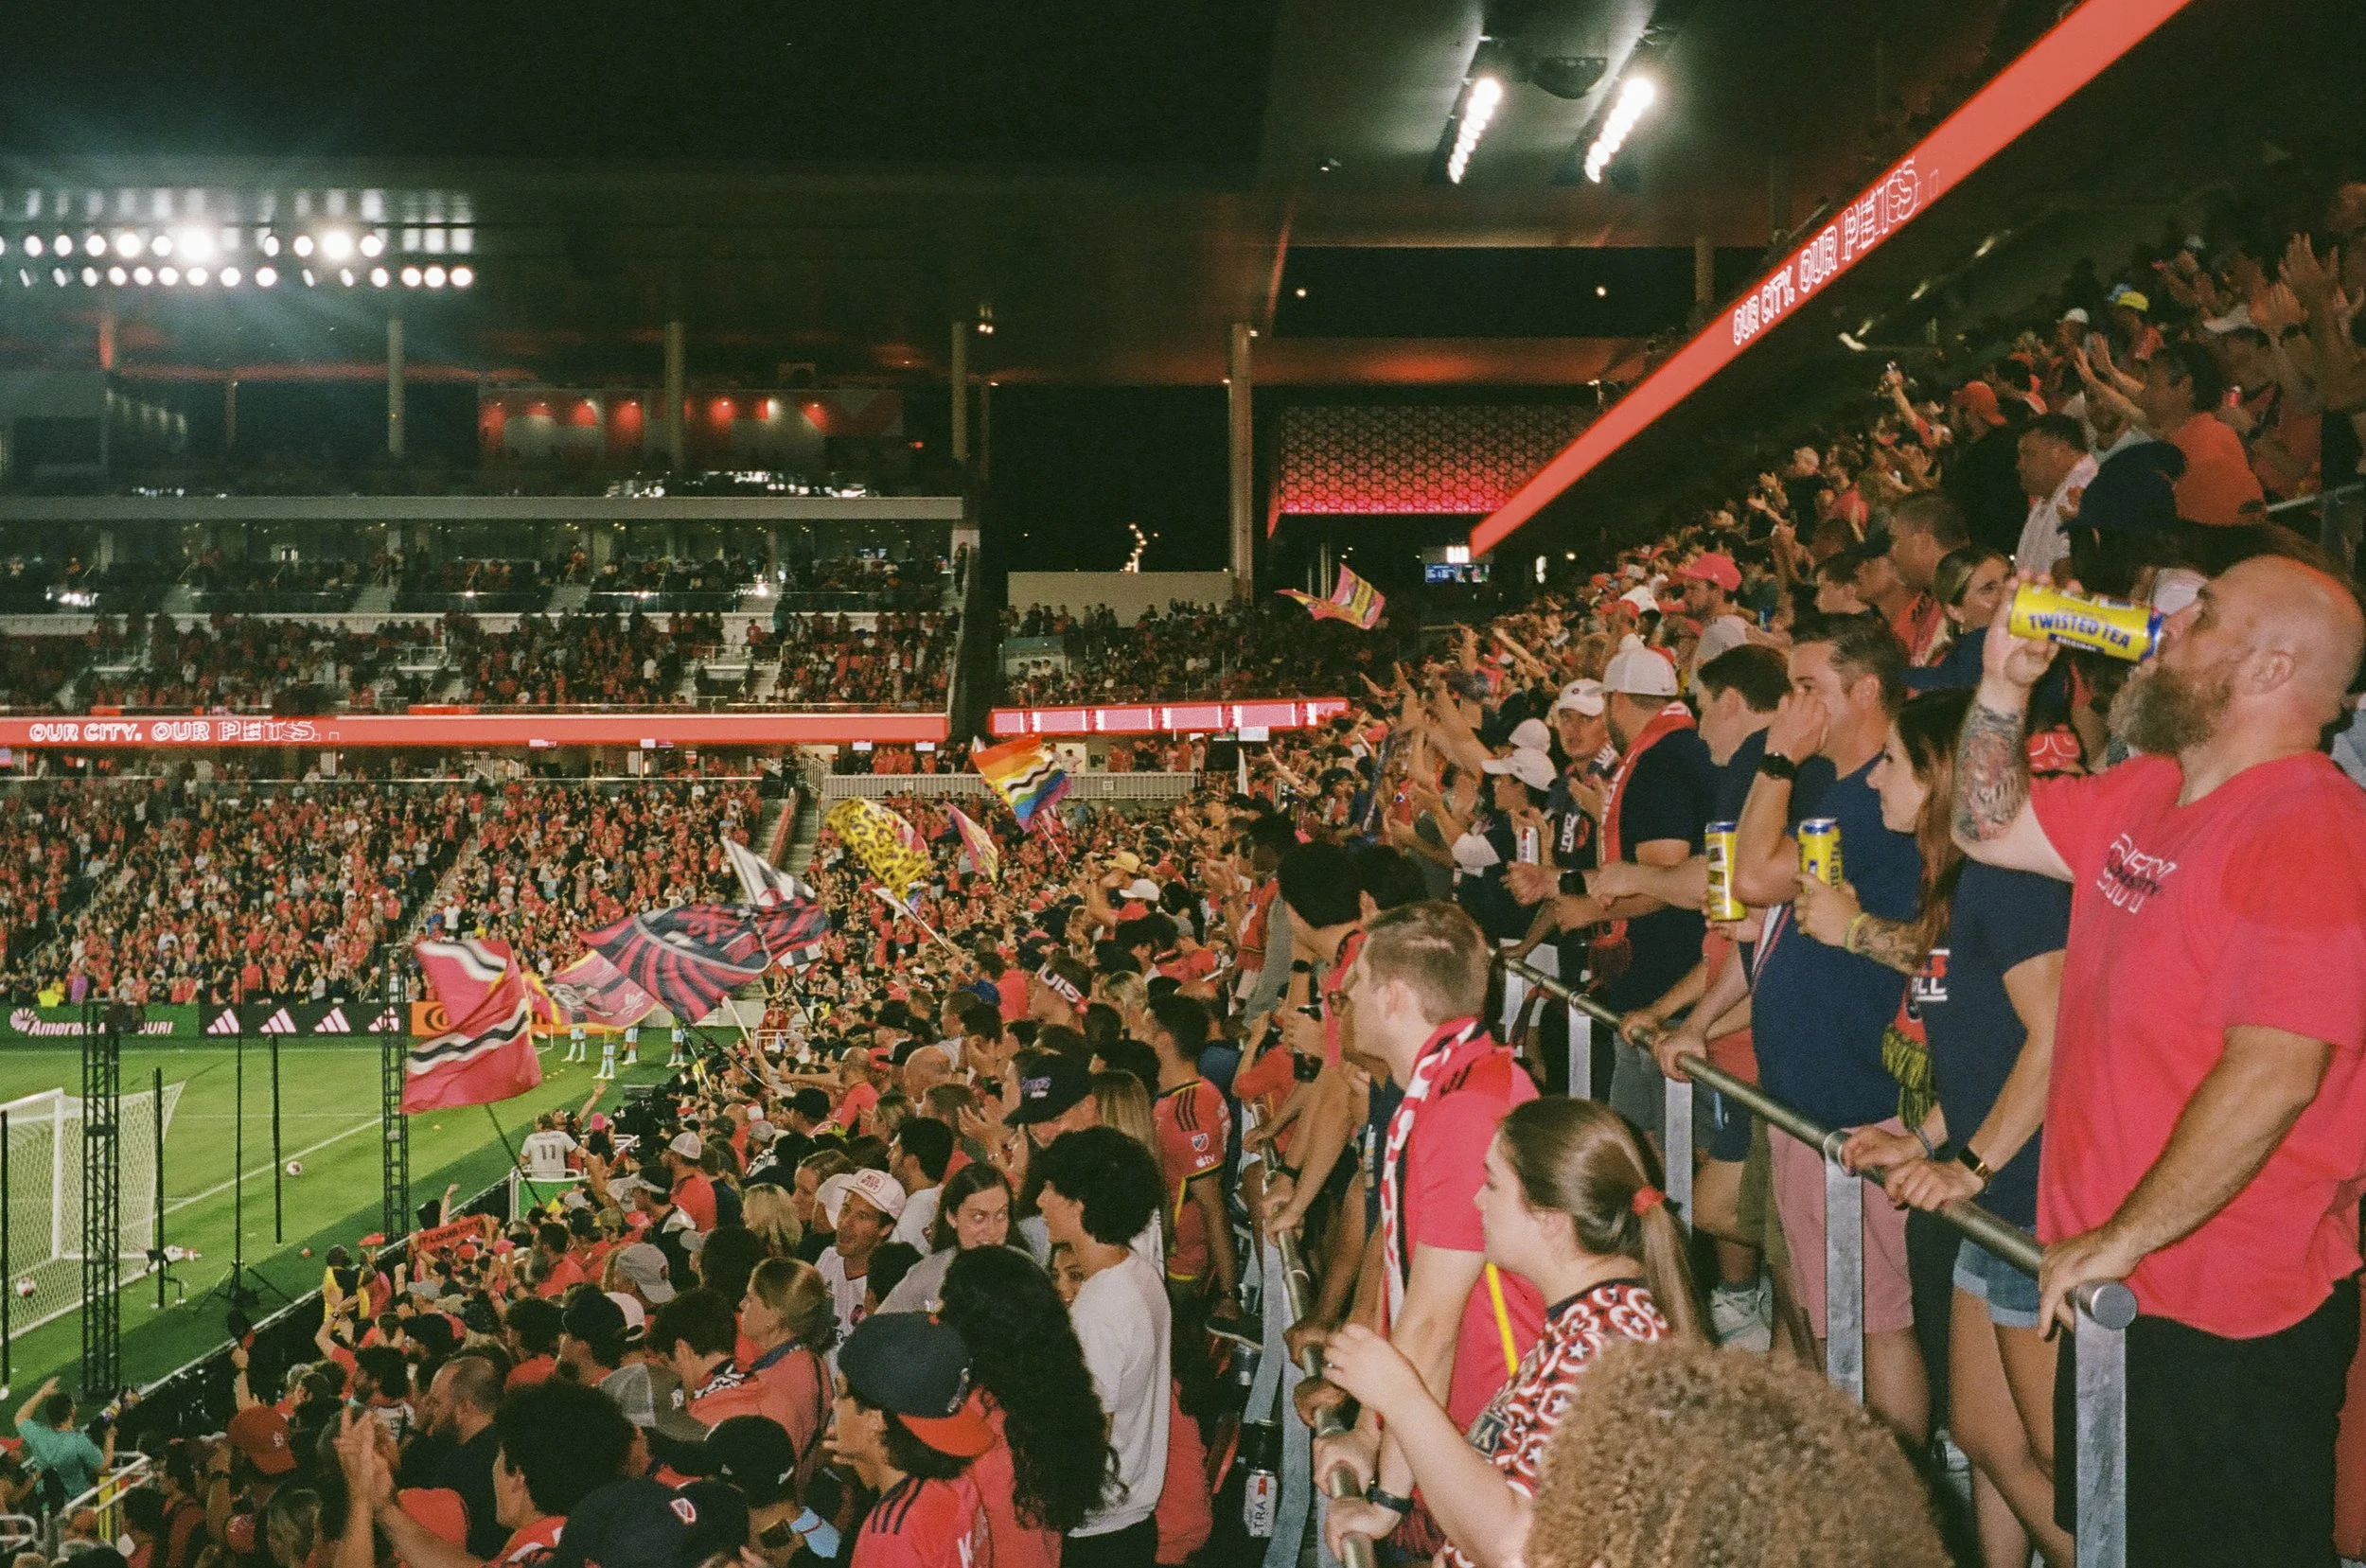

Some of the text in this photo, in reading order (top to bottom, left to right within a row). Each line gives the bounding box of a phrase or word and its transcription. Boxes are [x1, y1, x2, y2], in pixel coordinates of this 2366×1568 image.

[1733, 295, 1760, 346] OUR
[1799, 226, 1838, 293] OUR
[2028, 613, 2099, 637] TWISTED
[2101, 625, 2132, 648] TEA
[29, 723, 79, 743] OUR
[151, 721, 210, 742] OUR
[539, 1144, 556, 1160] 11
